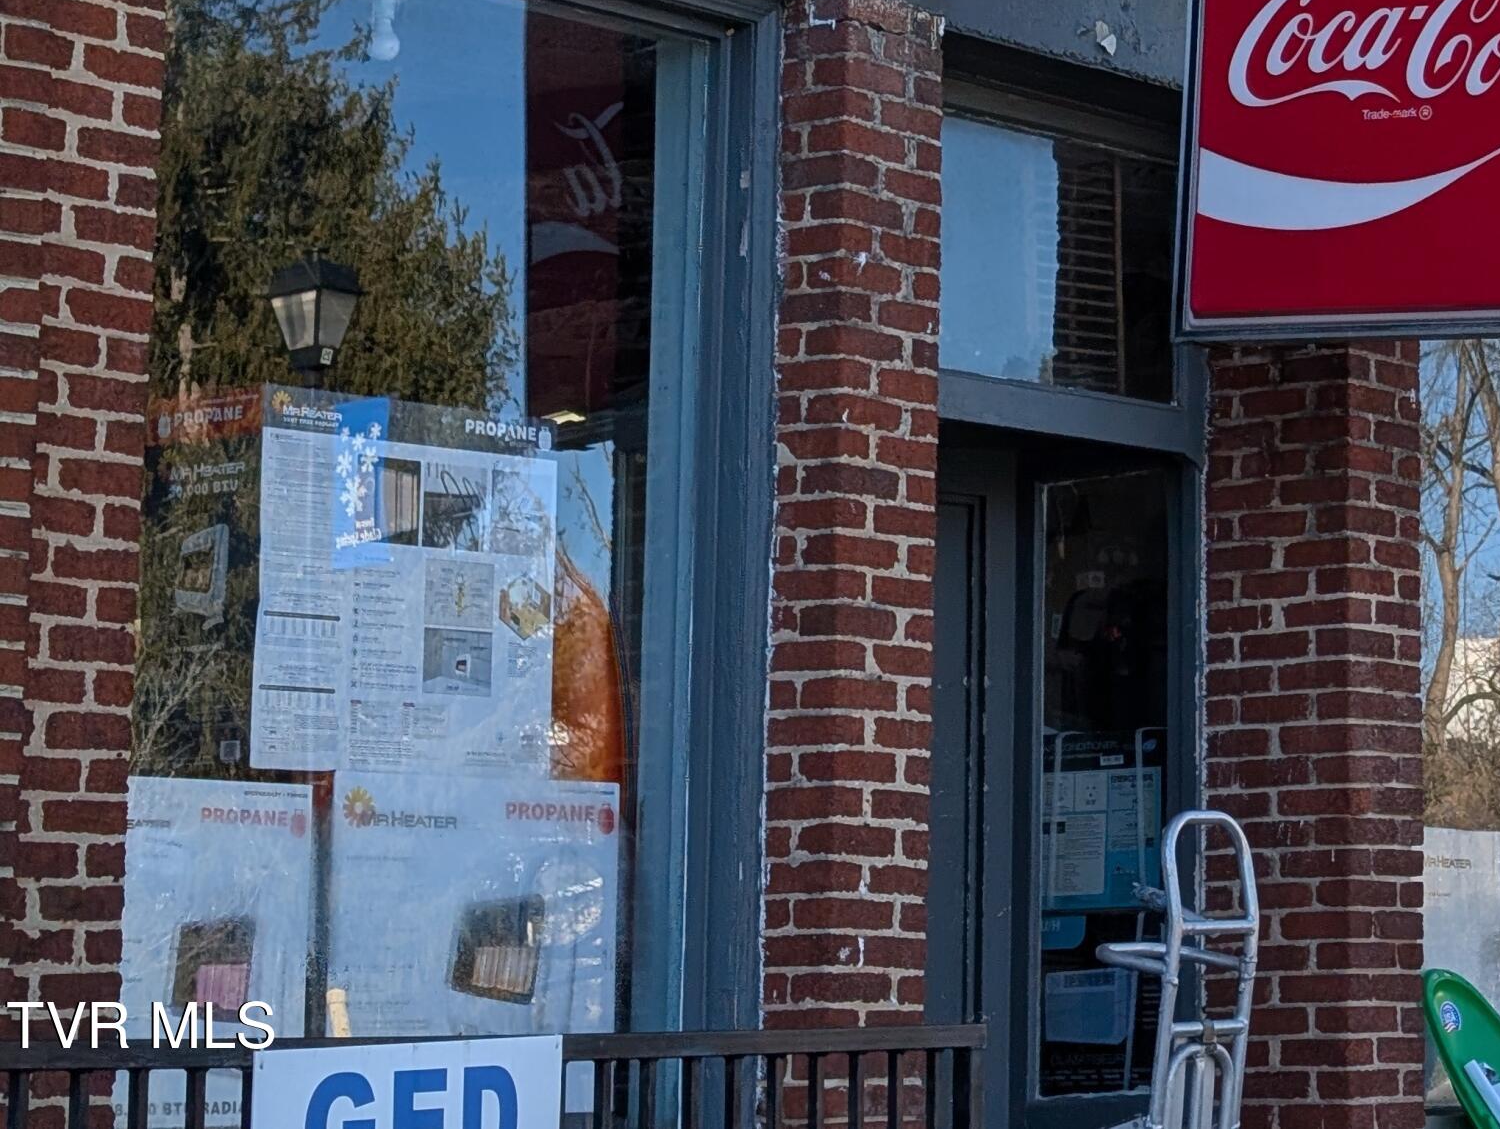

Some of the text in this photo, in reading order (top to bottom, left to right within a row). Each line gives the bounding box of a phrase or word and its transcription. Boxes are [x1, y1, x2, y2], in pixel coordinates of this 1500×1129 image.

[174, 405, 244, 426] PROPANE
[465, 419, 537, 442] PROPANE
[200, 807, 289, 827] PROPANE
[505, 801, 596, 822] PROPANE
[163, 1102, 187, 1116] BT
[204, 1101, 242, 1115] RADI
